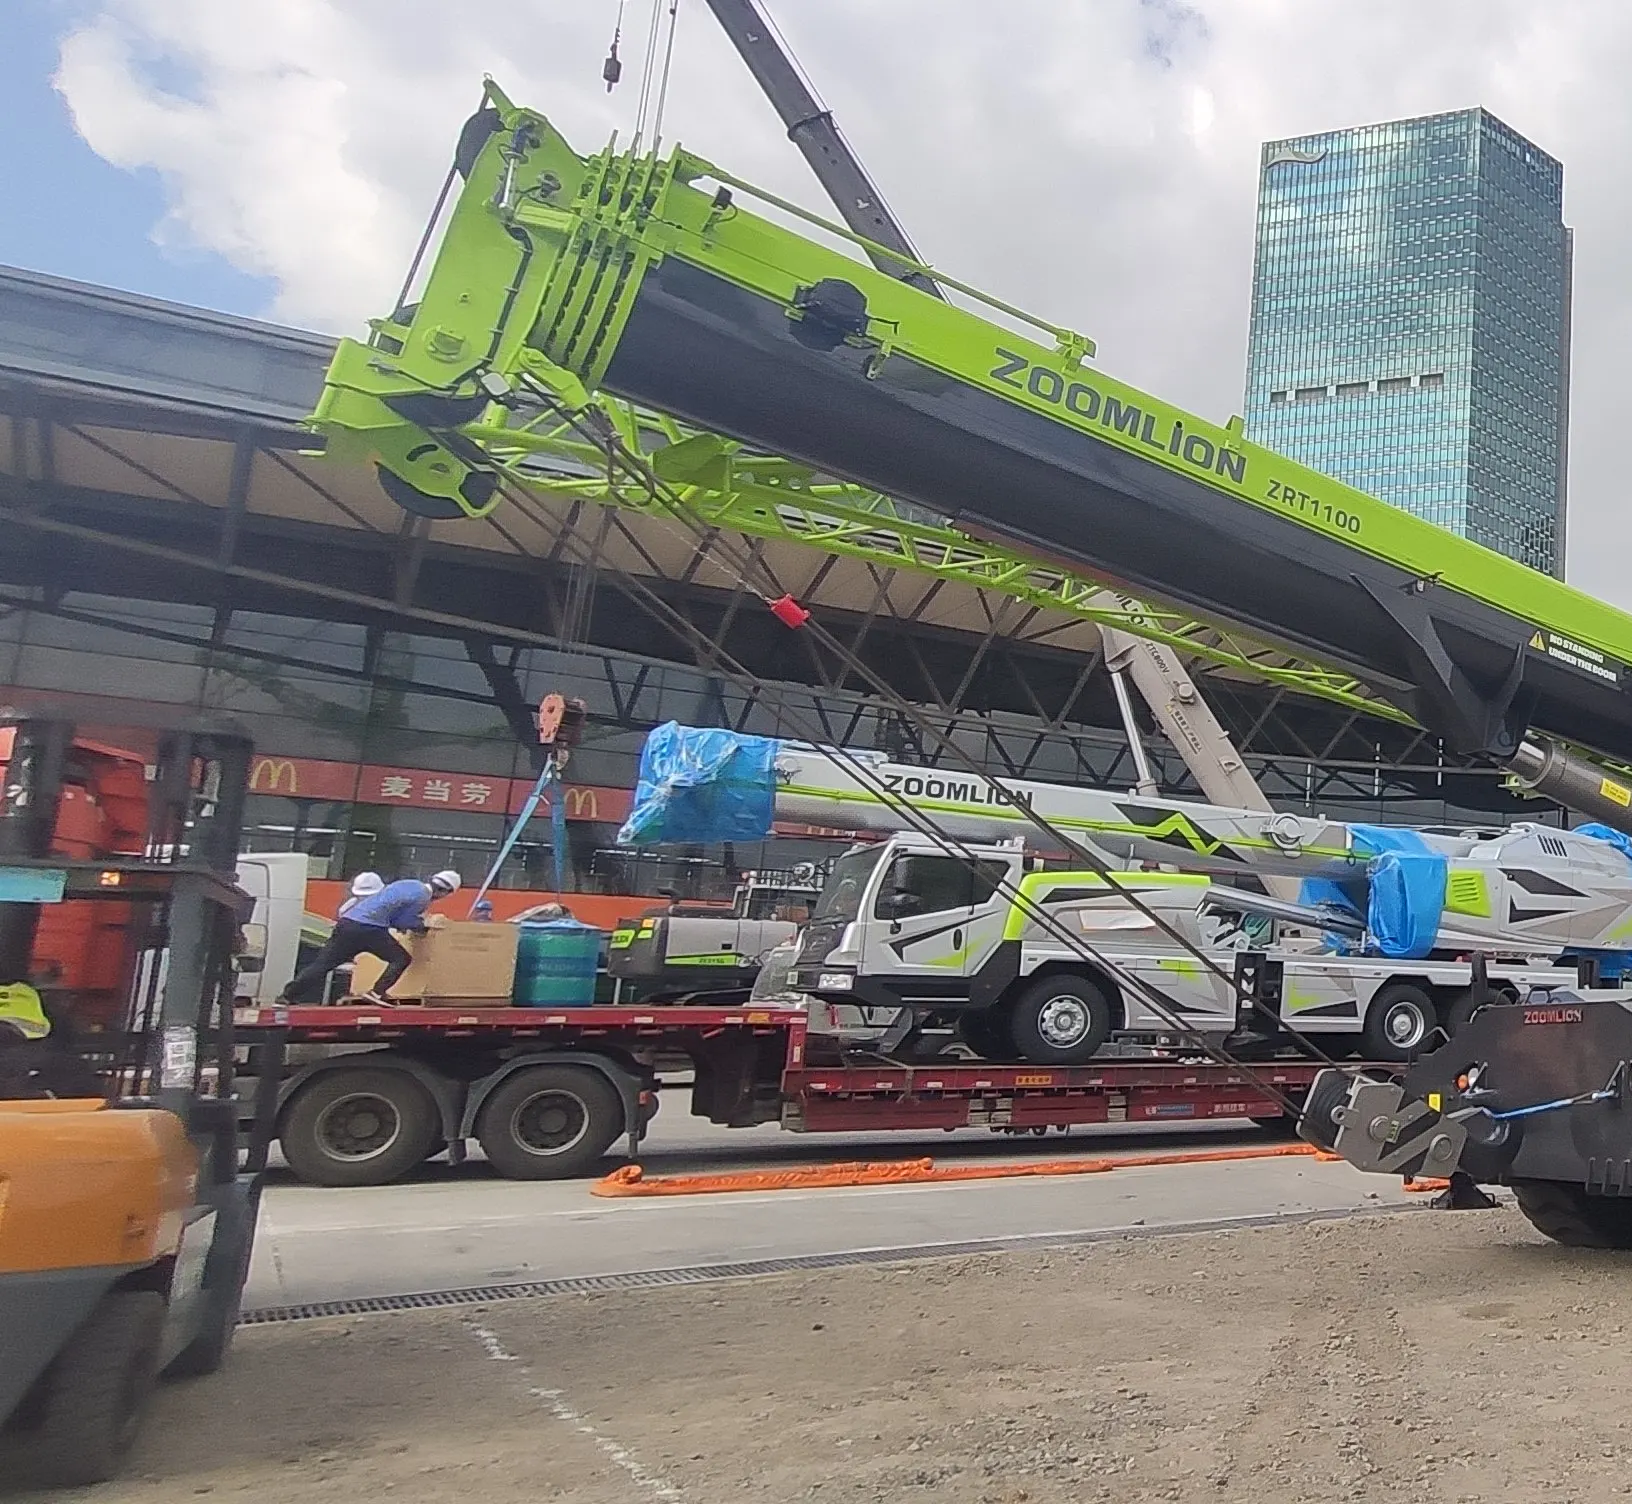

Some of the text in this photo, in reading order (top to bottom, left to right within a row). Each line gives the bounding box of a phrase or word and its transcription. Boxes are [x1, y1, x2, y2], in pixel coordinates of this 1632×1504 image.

[990, 347, 1361, 534] ZOOMLION ZRT1100
[1548, 646, 1617, 683] UNDER THE BOOM
[1549, 633, 1604, 664] NO STANDING
[380, 775, 492, 805] 麦当劳
[882, 774, 1034, 811] ZOOMLION
[1523, 1009, 1583, 1024] ZOOMLION
